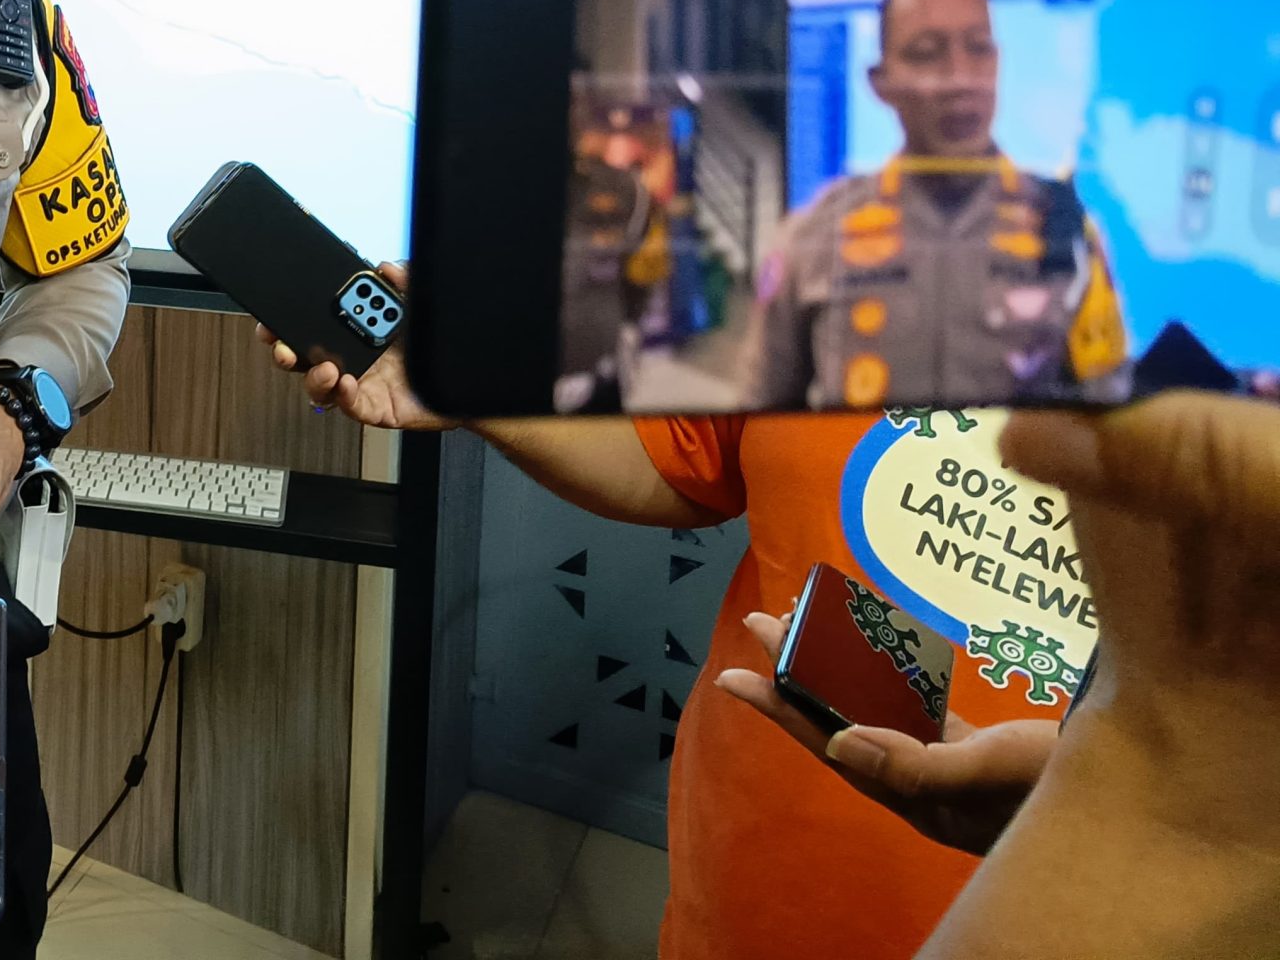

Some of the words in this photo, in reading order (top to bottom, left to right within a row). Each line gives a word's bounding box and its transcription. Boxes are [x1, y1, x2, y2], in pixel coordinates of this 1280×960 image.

[38, 143, 115, 222] KASA
[46, 240, 82, 265] OPS
[935, 458, 1017, 513] 80%
[900, 482, 1090, 584] LAKI-LAK
[916, 530, 1098, 629] NYELEWE
